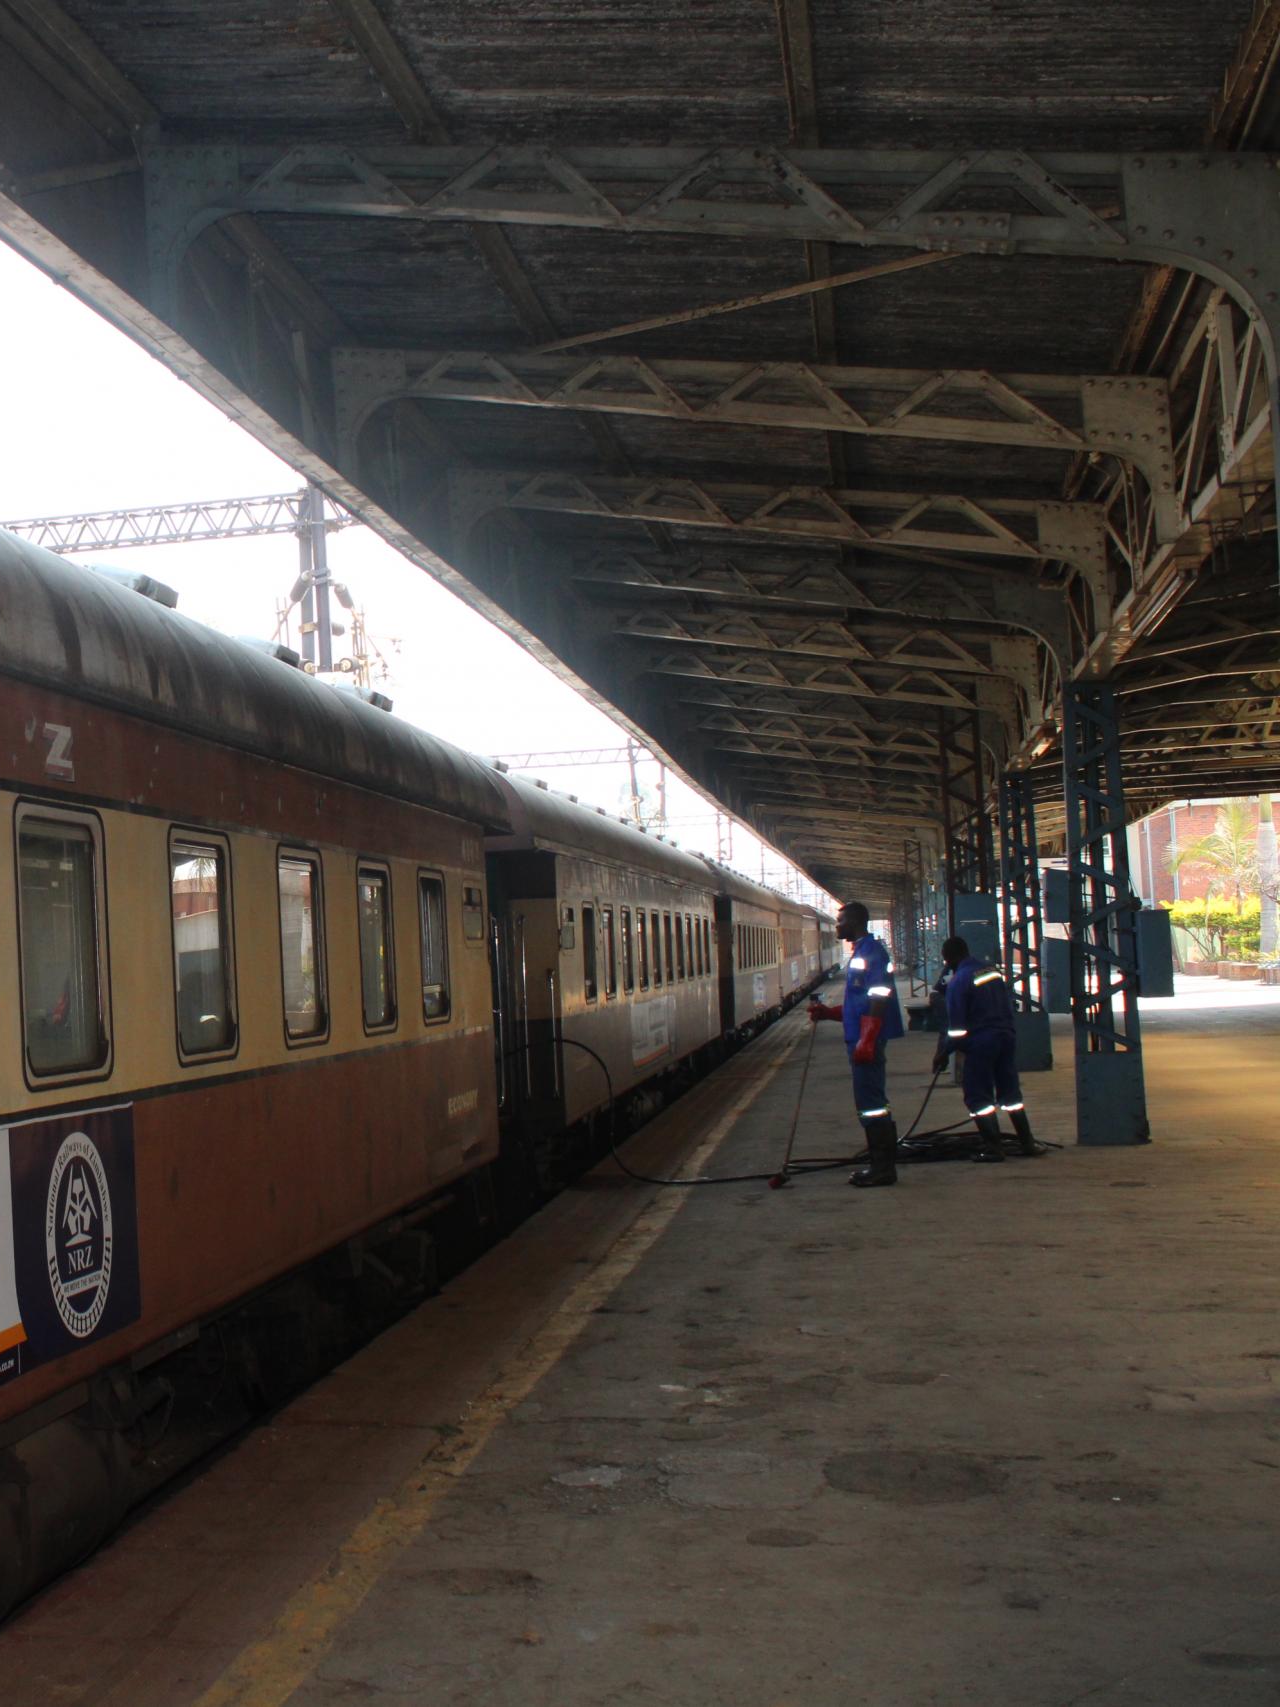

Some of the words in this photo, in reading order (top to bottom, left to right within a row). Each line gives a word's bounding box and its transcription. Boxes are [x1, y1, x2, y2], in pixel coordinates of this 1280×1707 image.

[57, 1142, 82, 1170] Railways
[82, 1143, 90, 1156] of
[67, 1245, 94, 1274] NRZ
